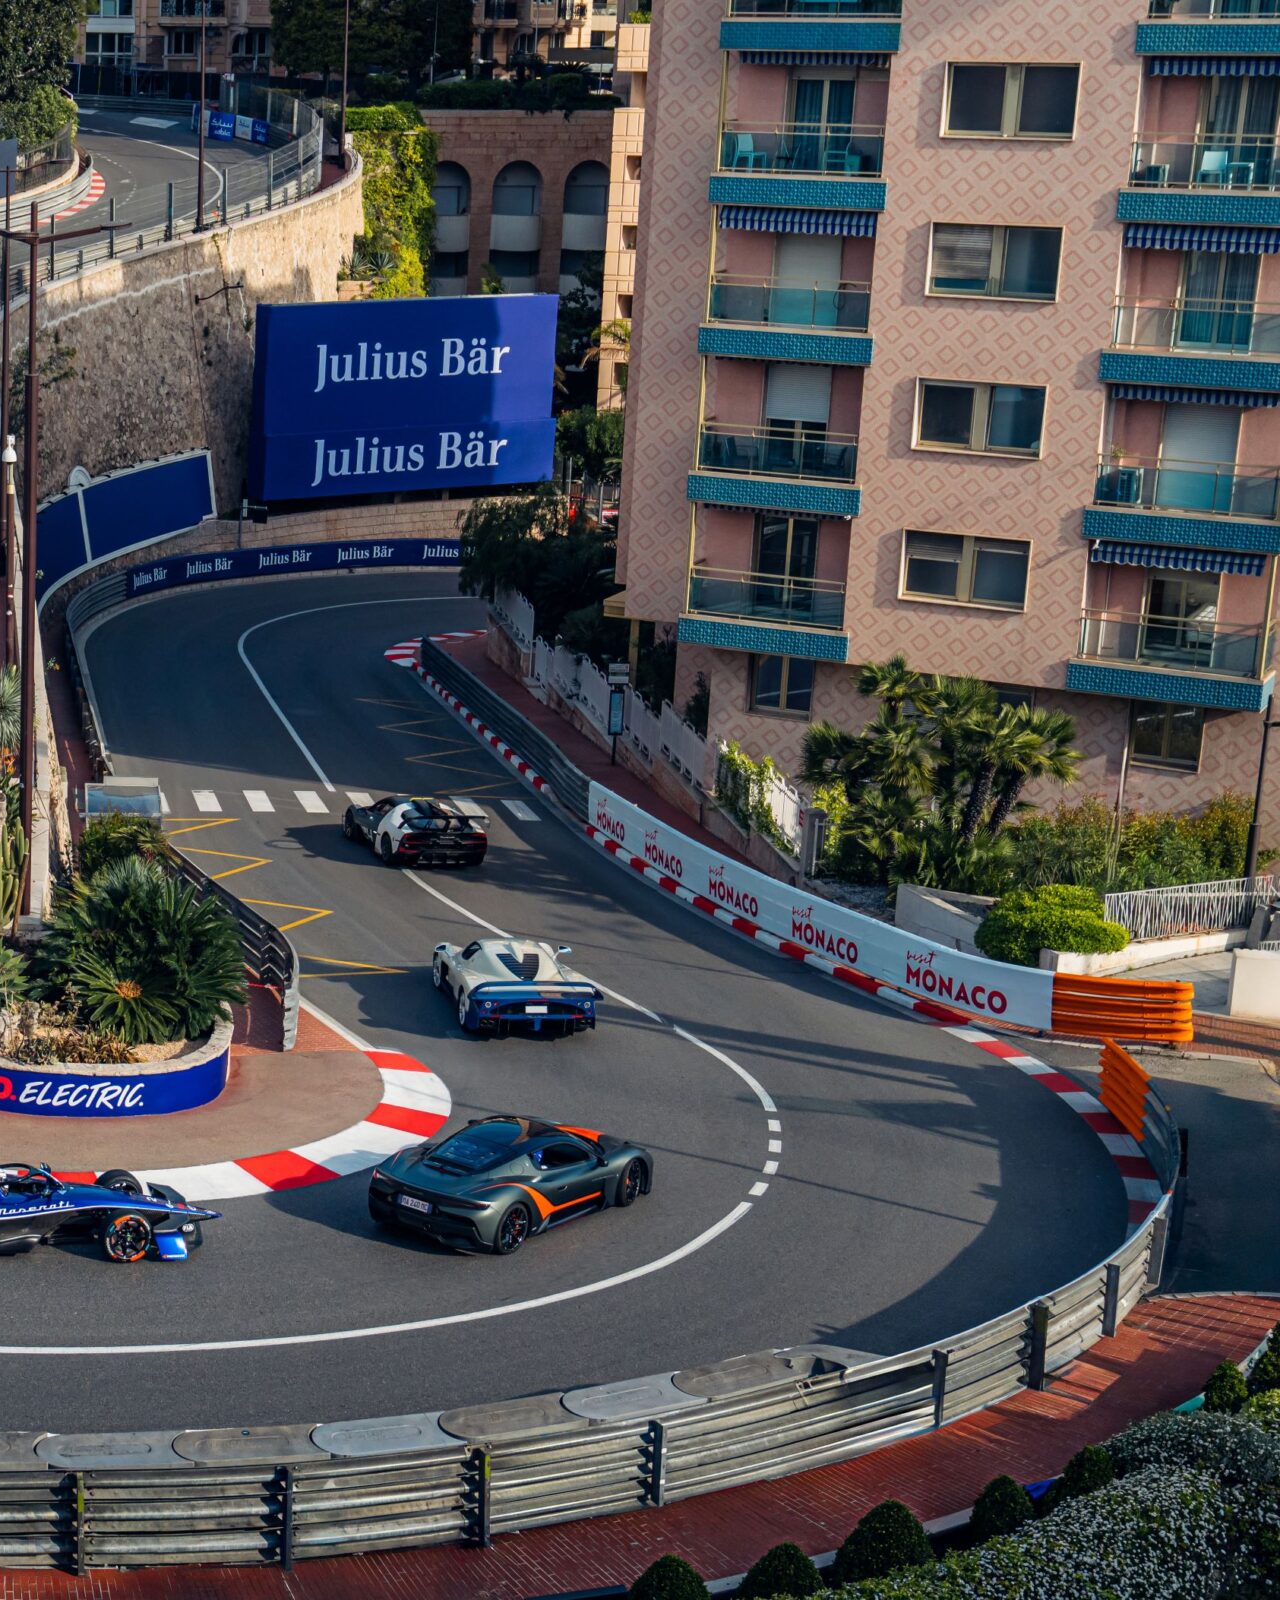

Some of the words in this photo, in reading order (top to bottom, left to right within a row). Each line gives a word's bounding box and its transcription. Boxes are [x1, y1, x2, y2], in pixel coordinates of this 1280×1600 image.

[314, 342, 427, 392] Julius
[439, 337, 510, 377] Bär
[311, 437, 424, 487] Julius
[436, 431, 508, 469] Bär
[259, 553, 289, 569] Julius
[292, 550, 312, 564] Bär
[337, 548, 370, 563] Julius
[373, 545, 394, 559] Bär
[422, 544, 459, 560] Julius
[133, 572, 152, 591] Julius
[153, 567, 168, 583] Bär
[186, 561, 212, 578] Julius
[215, 557, 233, 572] Bär
[597, 812, 625, 842] MONACO
[645, 841, 683, 878] MONACO
[709, 879, 758, 917] MONACO
[792, 905, 812, 922] visit
[792, 919, 858, 964] MONACO
[906, 950, 936, 968] visit
[906, 963, 1008, 1015] MONACO
[19, 1081, 145, 1110] ELECTRIC.
